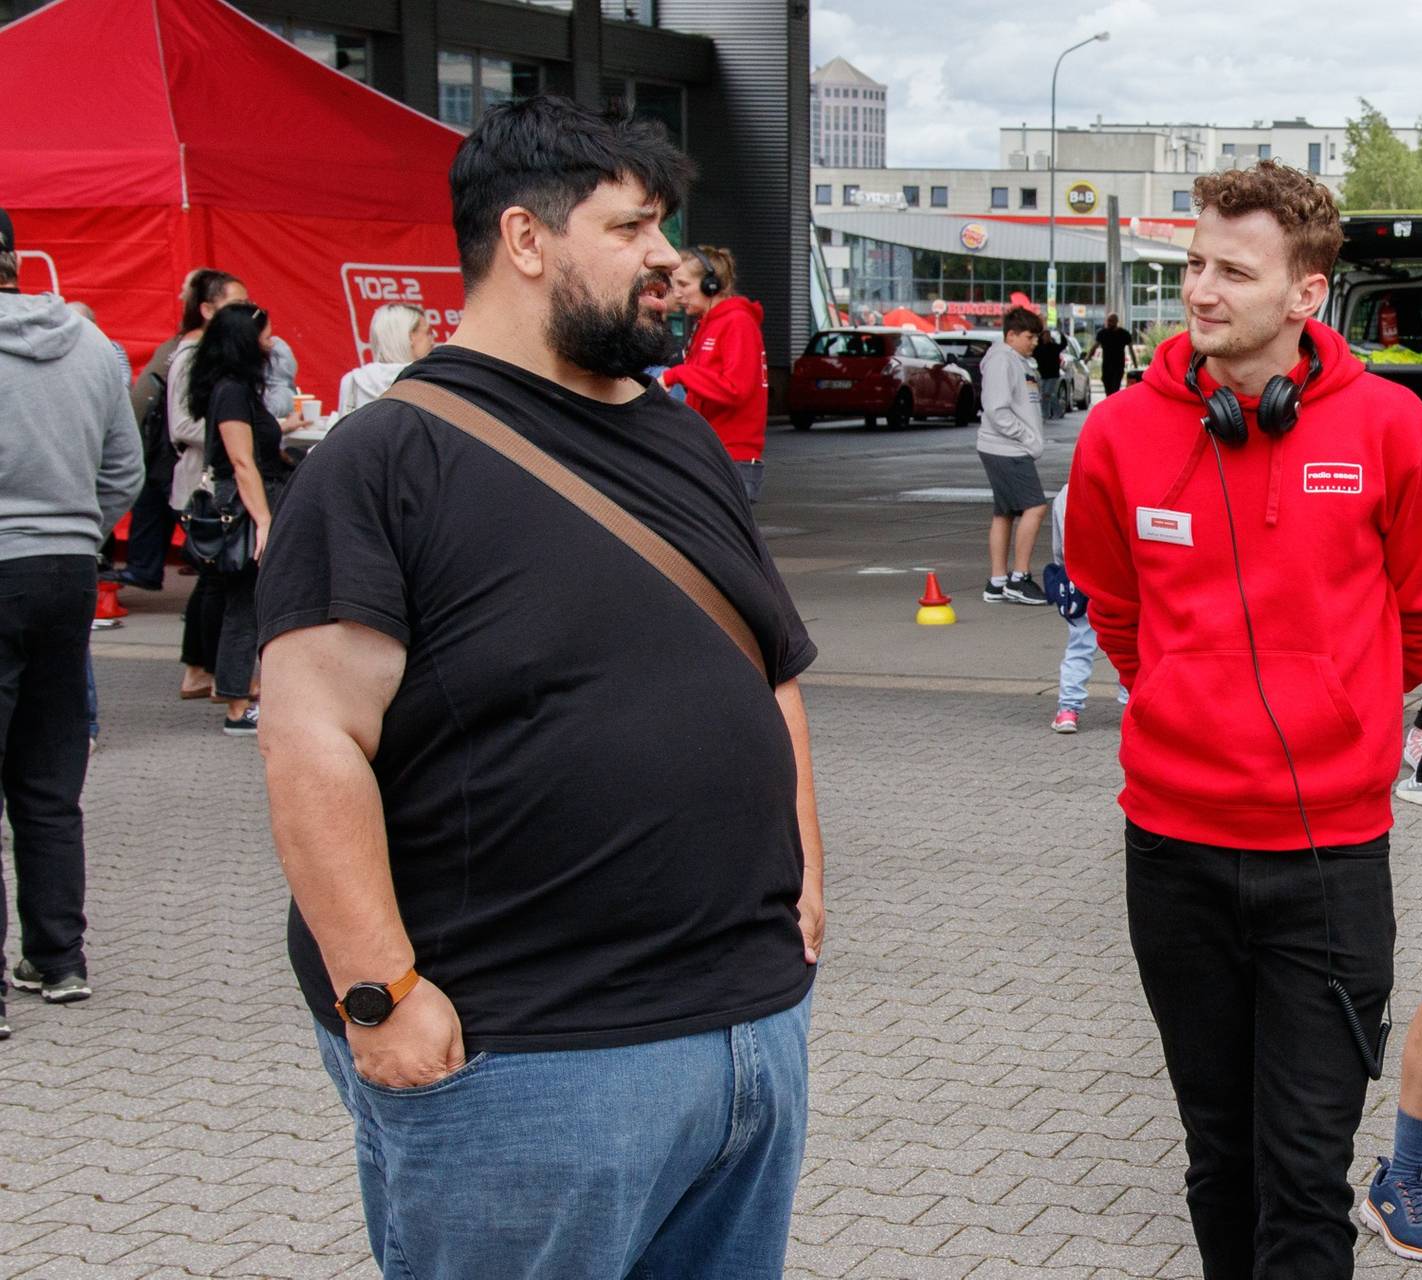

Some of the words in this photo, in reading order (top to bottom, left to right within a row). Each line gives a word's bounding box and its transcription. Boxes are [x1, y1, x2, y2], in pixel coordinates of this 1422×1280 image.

[1070, 191, 1094, 203] B&B
[354, 276, 423, 300] 102.2
[948, 302, 999, 315] BURGER
